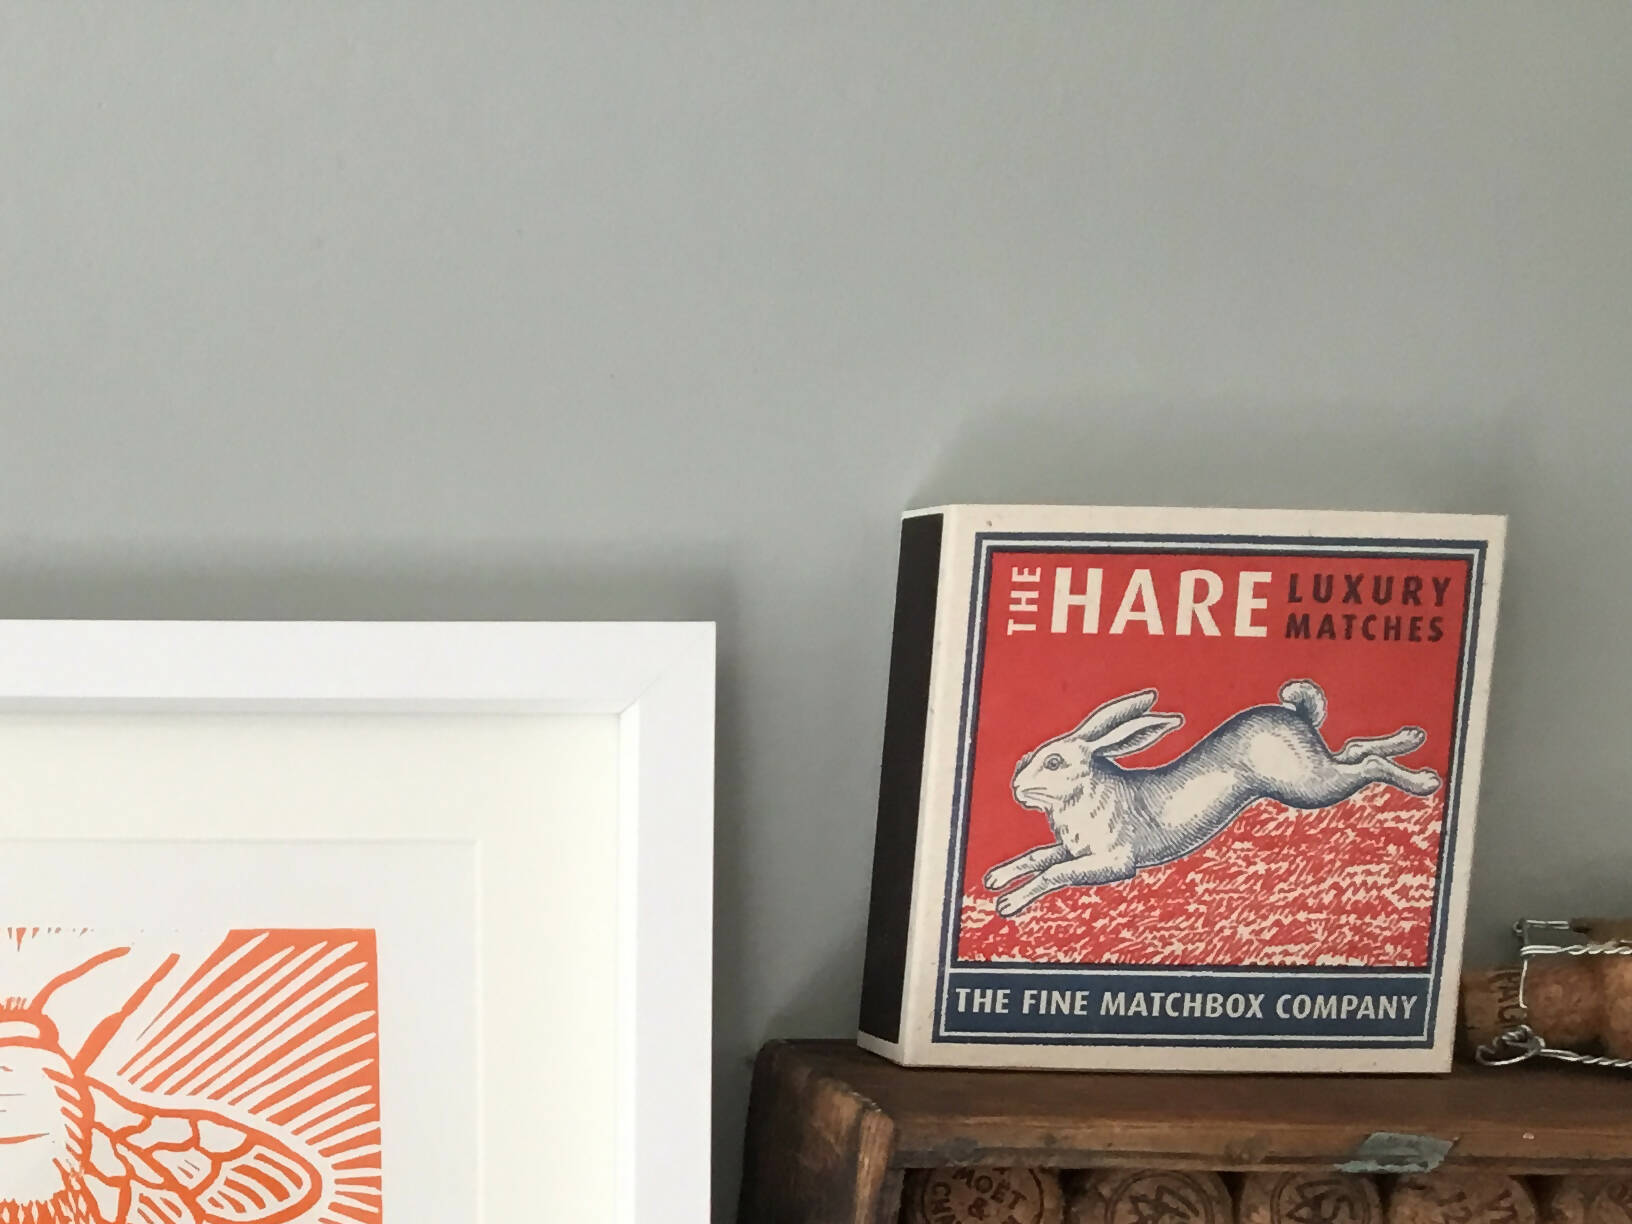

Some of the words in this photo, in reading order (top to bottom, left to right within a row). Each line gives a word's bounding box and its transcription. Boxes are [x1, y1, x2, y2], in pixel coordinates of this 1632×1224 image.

[1007, 566, 1042, 636] THE
[1050, 566, 1273, 639] HARE
[1286, 572, 1453, 609] LUXURY
[1284, 612, 1446, 643] MATCHES
[955, 987, 1011, 1014] THE
[1022, 989, 1090, 1017] FINE
[1099, 990, 1265, 1020] MATCHBOX
[1276, 993, 1418, 1021] COMPANY
